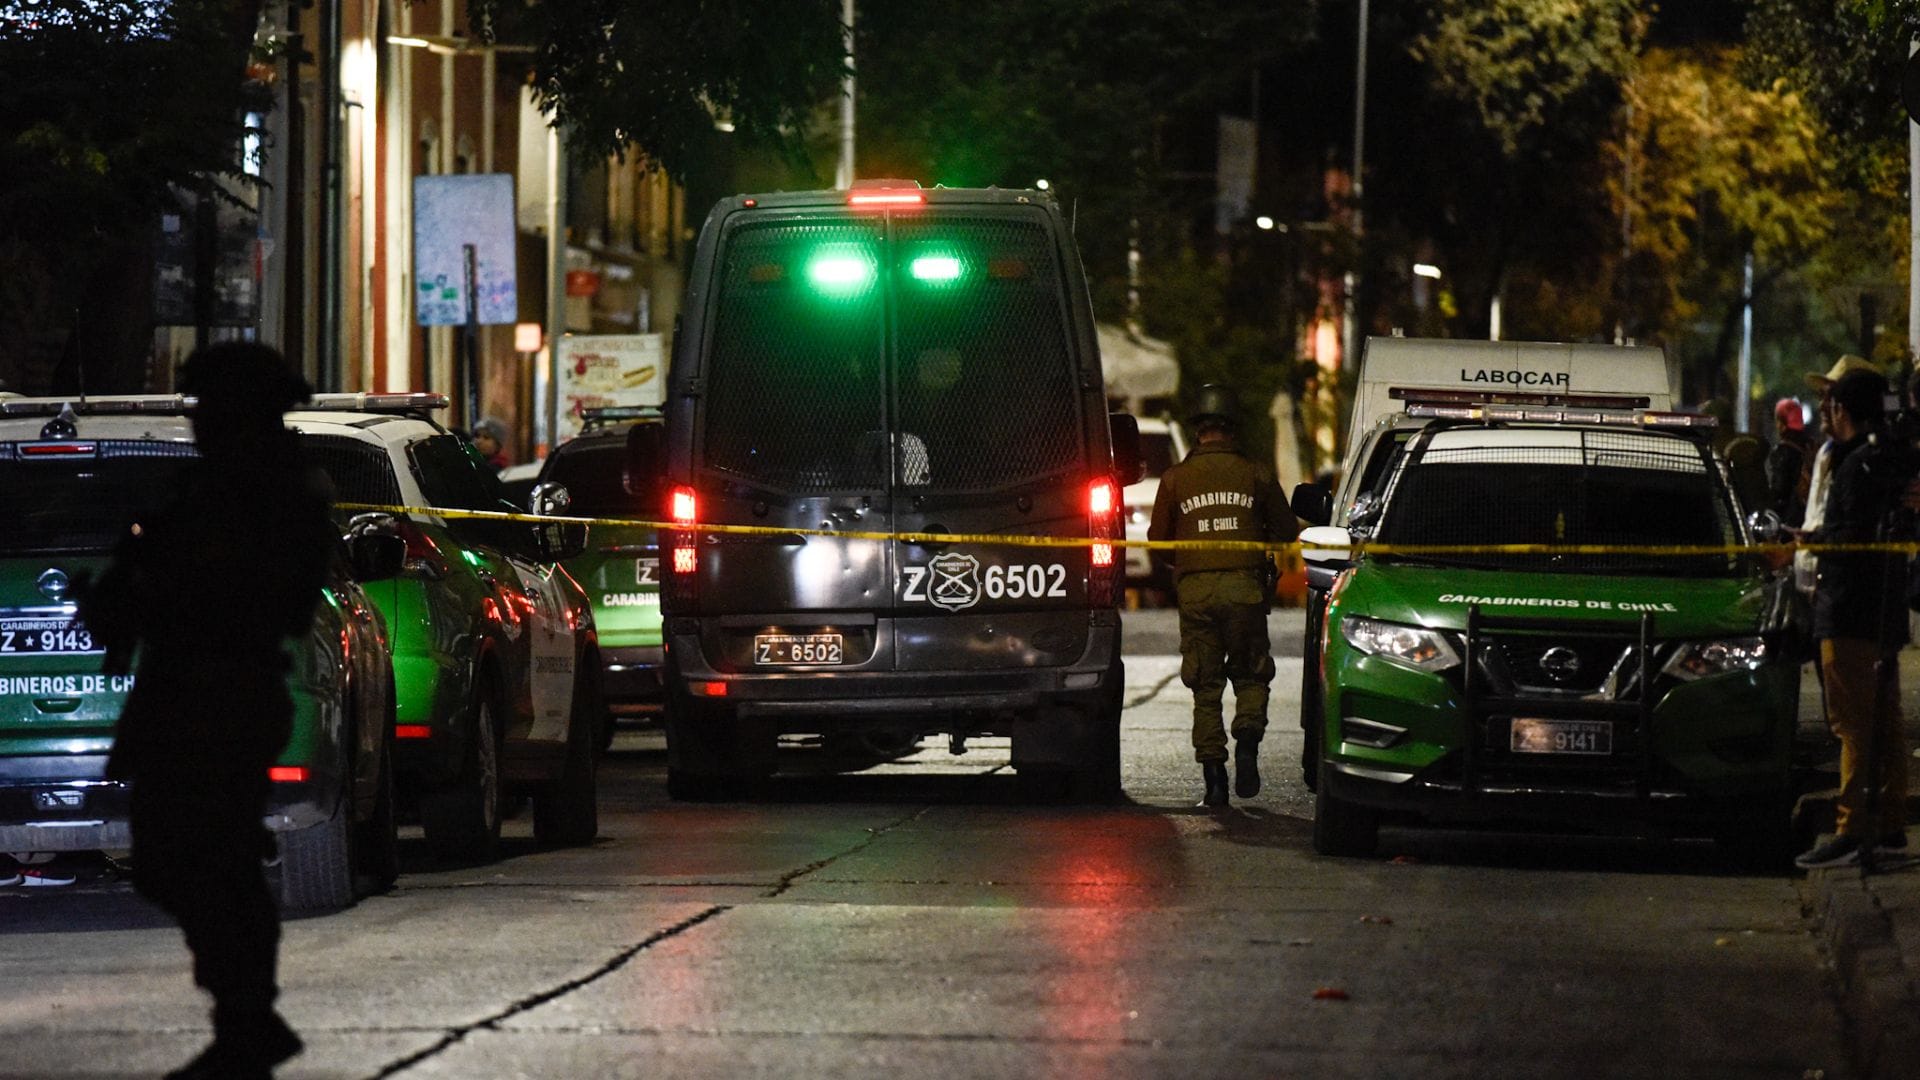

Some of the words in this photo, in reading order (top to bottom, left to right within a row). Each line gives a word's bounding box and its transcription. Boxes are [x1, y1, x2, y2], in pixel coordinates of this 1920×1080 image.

[1460, 368, 1570, 386] LABOCAR
[1180, 491, 1255, 515] CARABINEROS
[1197, 519, 1210, 533] DE
[1212, 517, 1239, 531] CHILE
[640, 567, 652, 582] Z
[903, 566, 927, 602] Z
[984, 563, 1067, 599] 6502
[1438, 593, 1580, 608] CARABINEROS
[1585, 600, 1613, 610] DE
[1617, 602, 1678, 613] CHILE
[0, 621, 57, 631] CARABINEROS
[1, 631, 16, 652] Z
[40, 630, 92, 651] 9143
[760, 643, 771, 662] Z
[791, 643, 840, 662] 6502
[0, 676, 76, 694] BINEROS
[82, 675, 105, 693] DE
[1555, 732, 1596, 750] 9141
